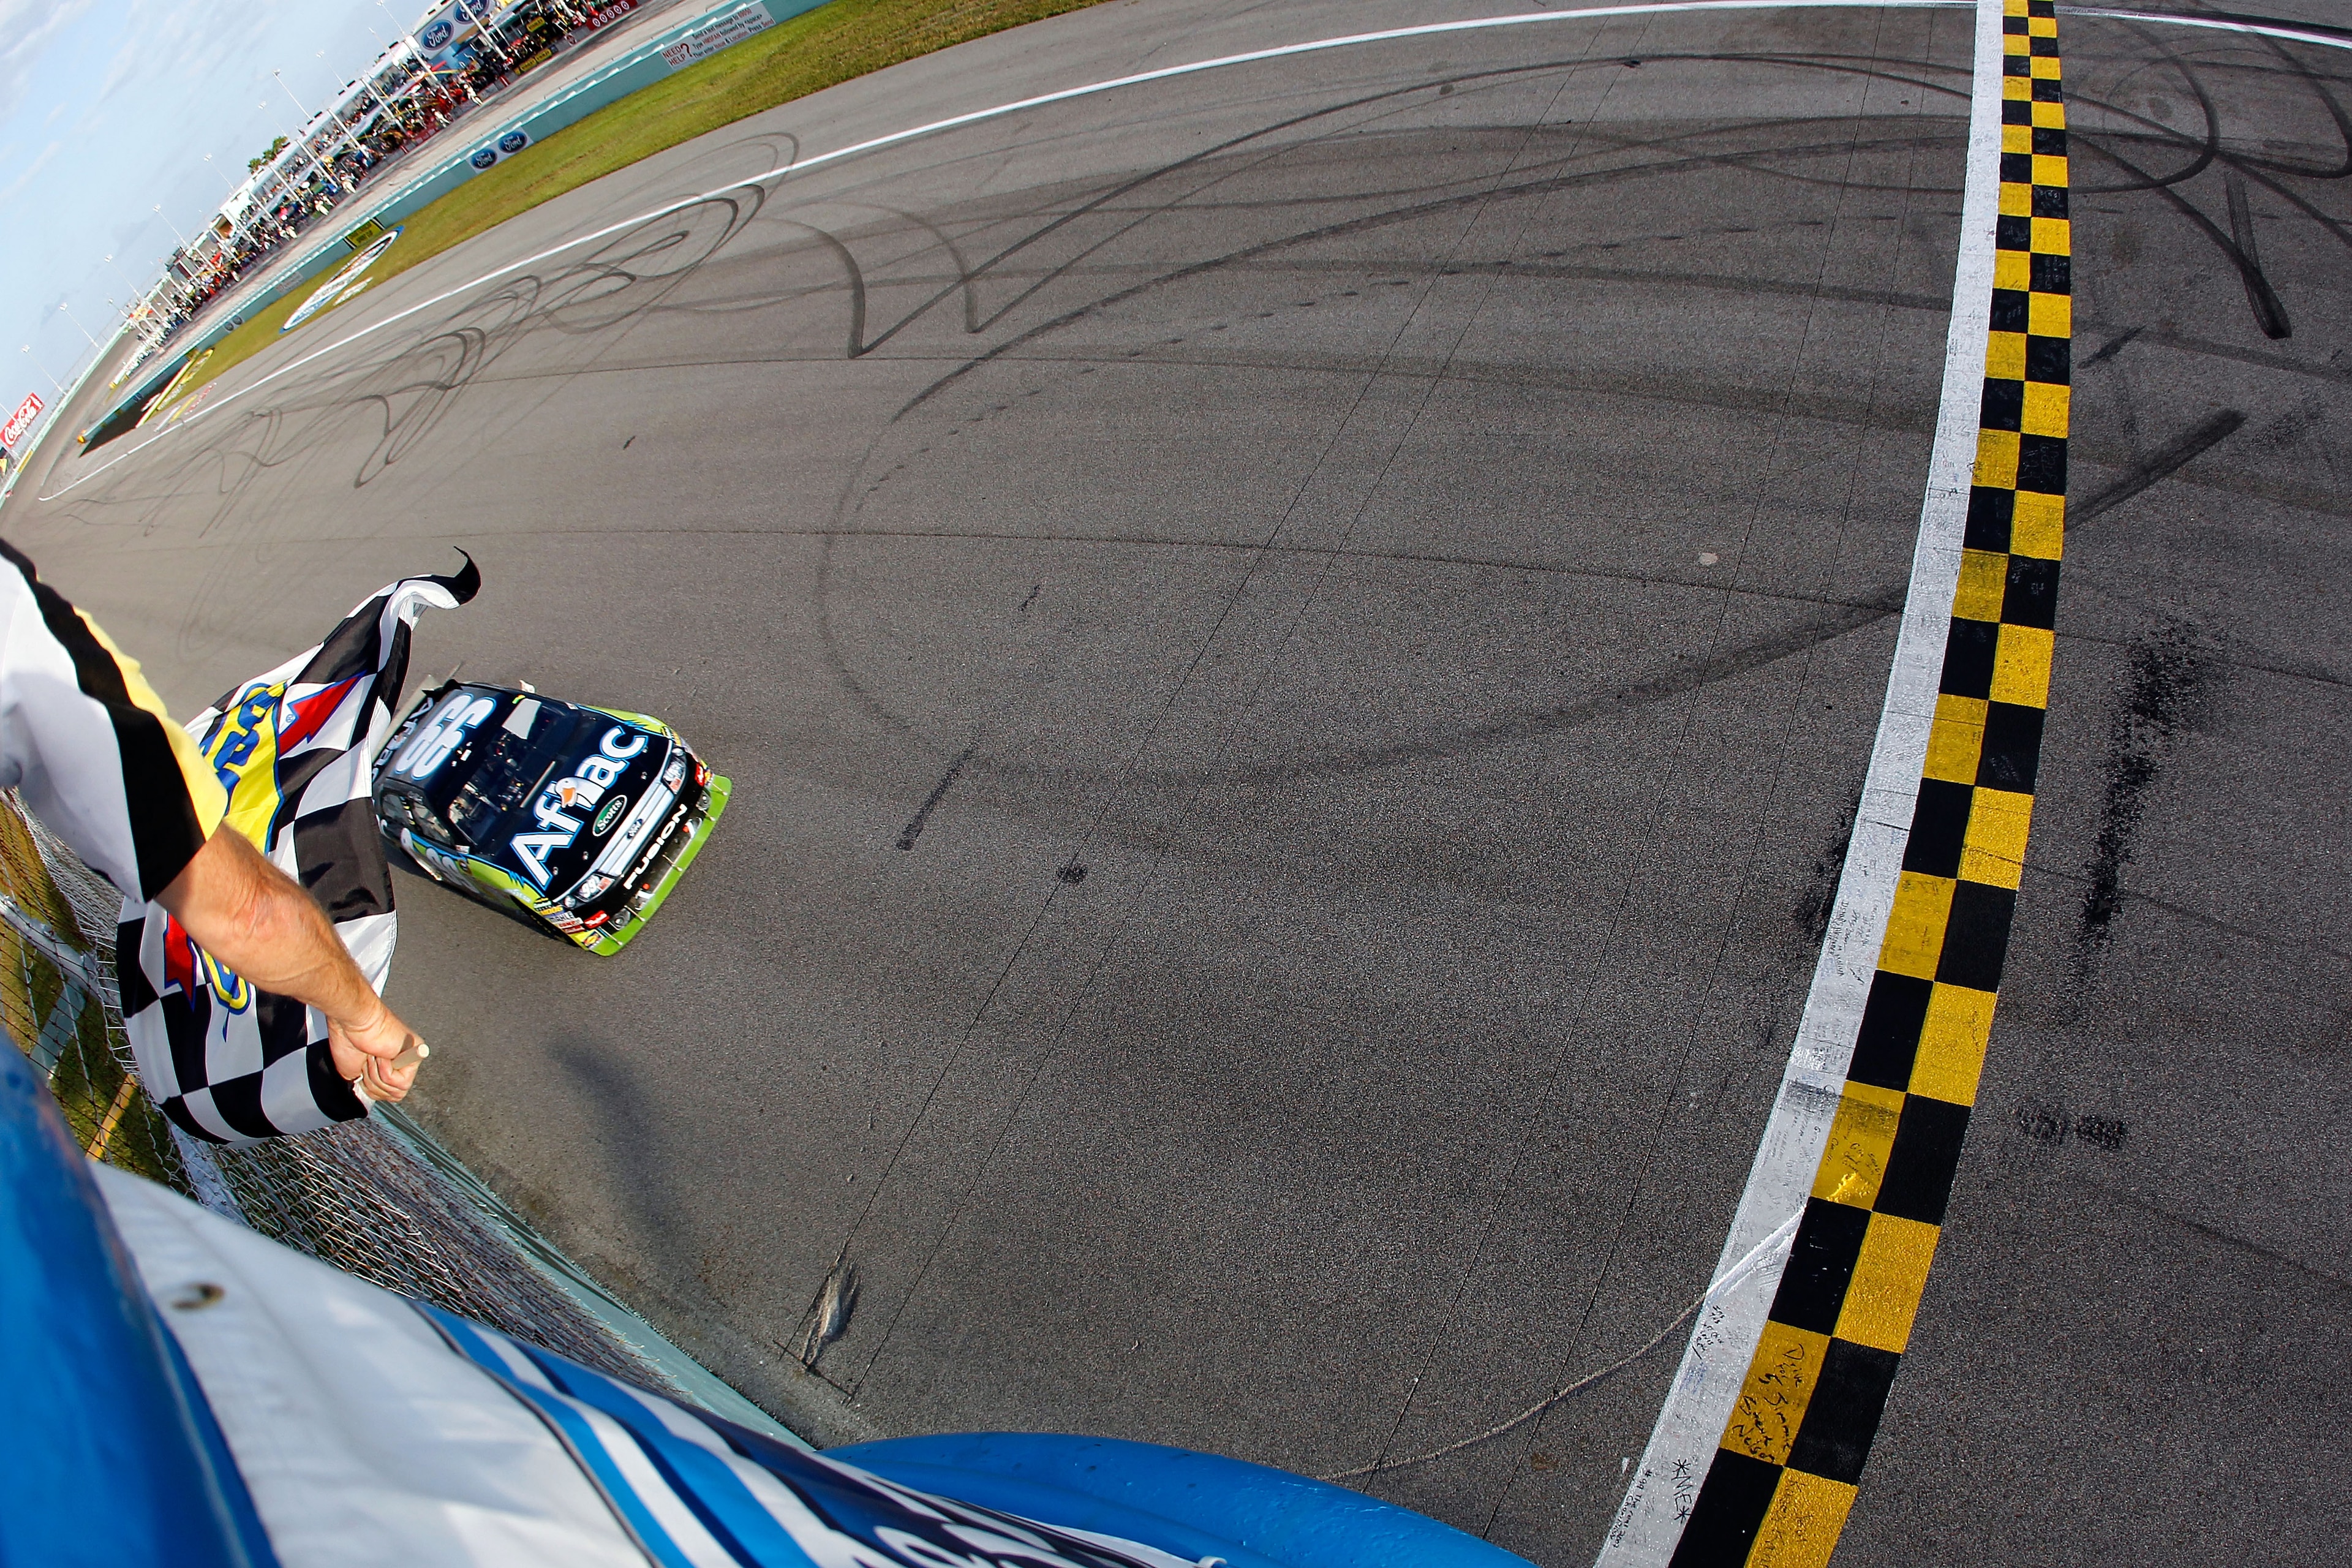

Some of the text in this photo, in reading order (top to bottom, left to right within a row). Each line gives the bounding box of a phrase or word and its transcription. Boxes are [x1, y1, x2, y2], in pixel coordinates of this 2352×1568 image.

[715, 18, 734, 31] message
[720, 24, 739, 36] followed
[738, 21, 745, 29] by
[748, 24, 763, 34] Press
[426, 24, 448, 47] Ford
[663, 46, 682, 59] NEED
[668, 53, 686, 66] HELP
[503, 135, 522, 151] Ford
[475, 151, 492, 167] Ford
[396, 693, 495, 780] 99
[511, 726, 648, 891] Aflac
[597, 799, 623, 832] Scotts
[624, 804, 688, 890] FUSION
[1782, 1343, 1804, 1388] Drive
